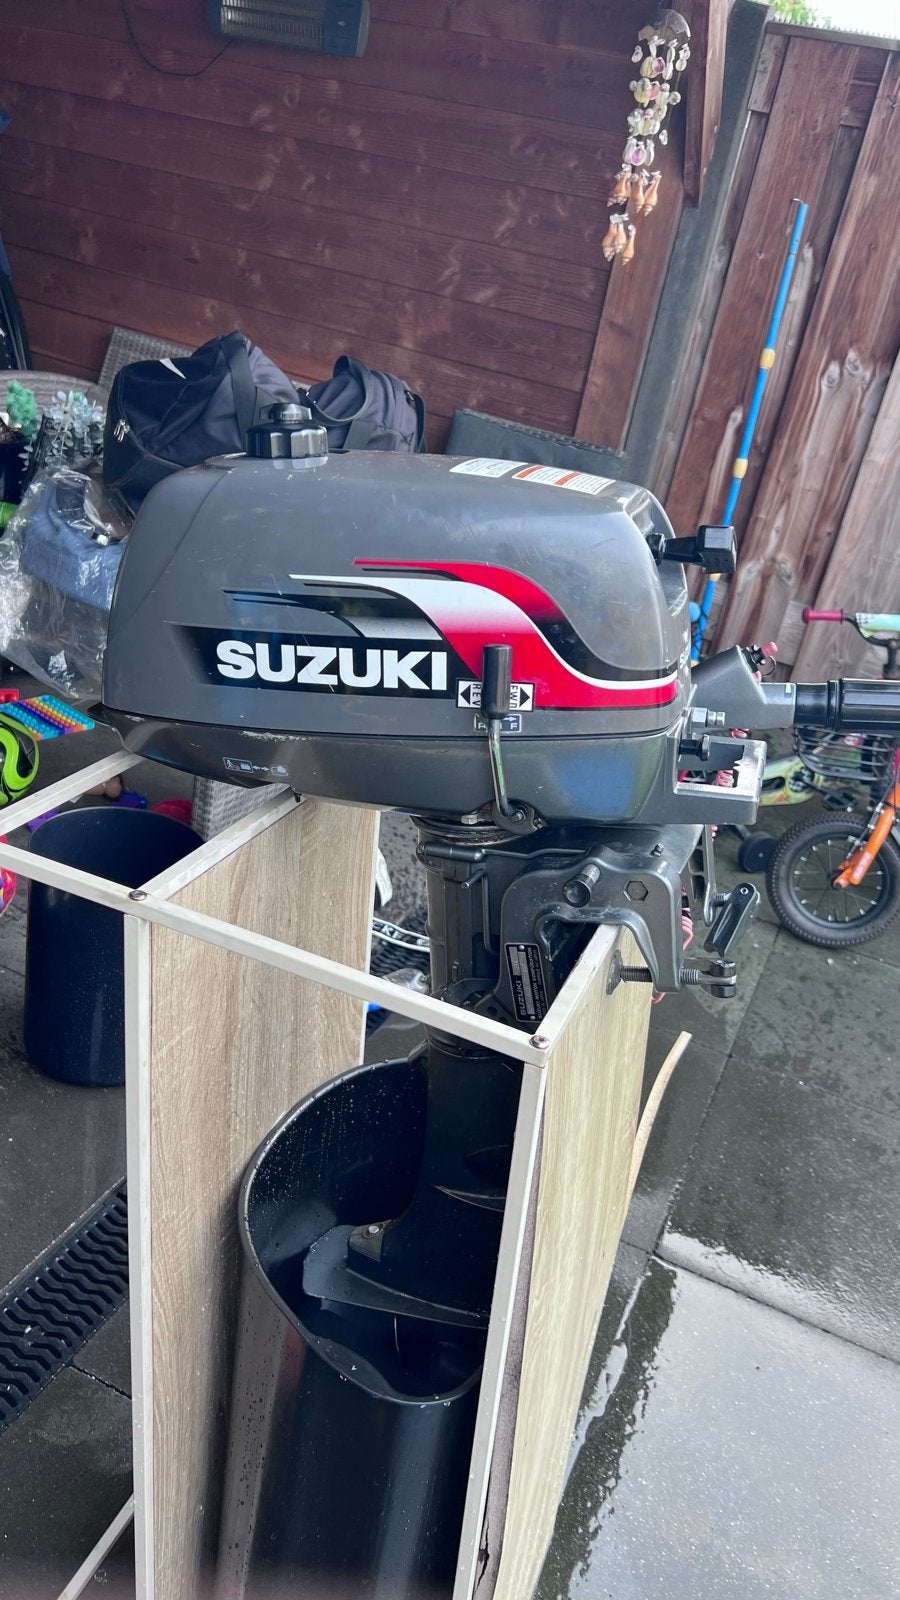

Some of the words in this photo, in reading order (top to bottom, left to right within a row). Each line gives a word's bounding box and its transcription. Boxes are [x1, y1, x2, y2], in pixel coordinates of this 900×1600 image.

[216, 640, 447, 691] SUZUKI
[472, 683, 482, 706] REV
[510, 722, 518, 730] F
[516, 981, 526, 1016] SUZUKI
